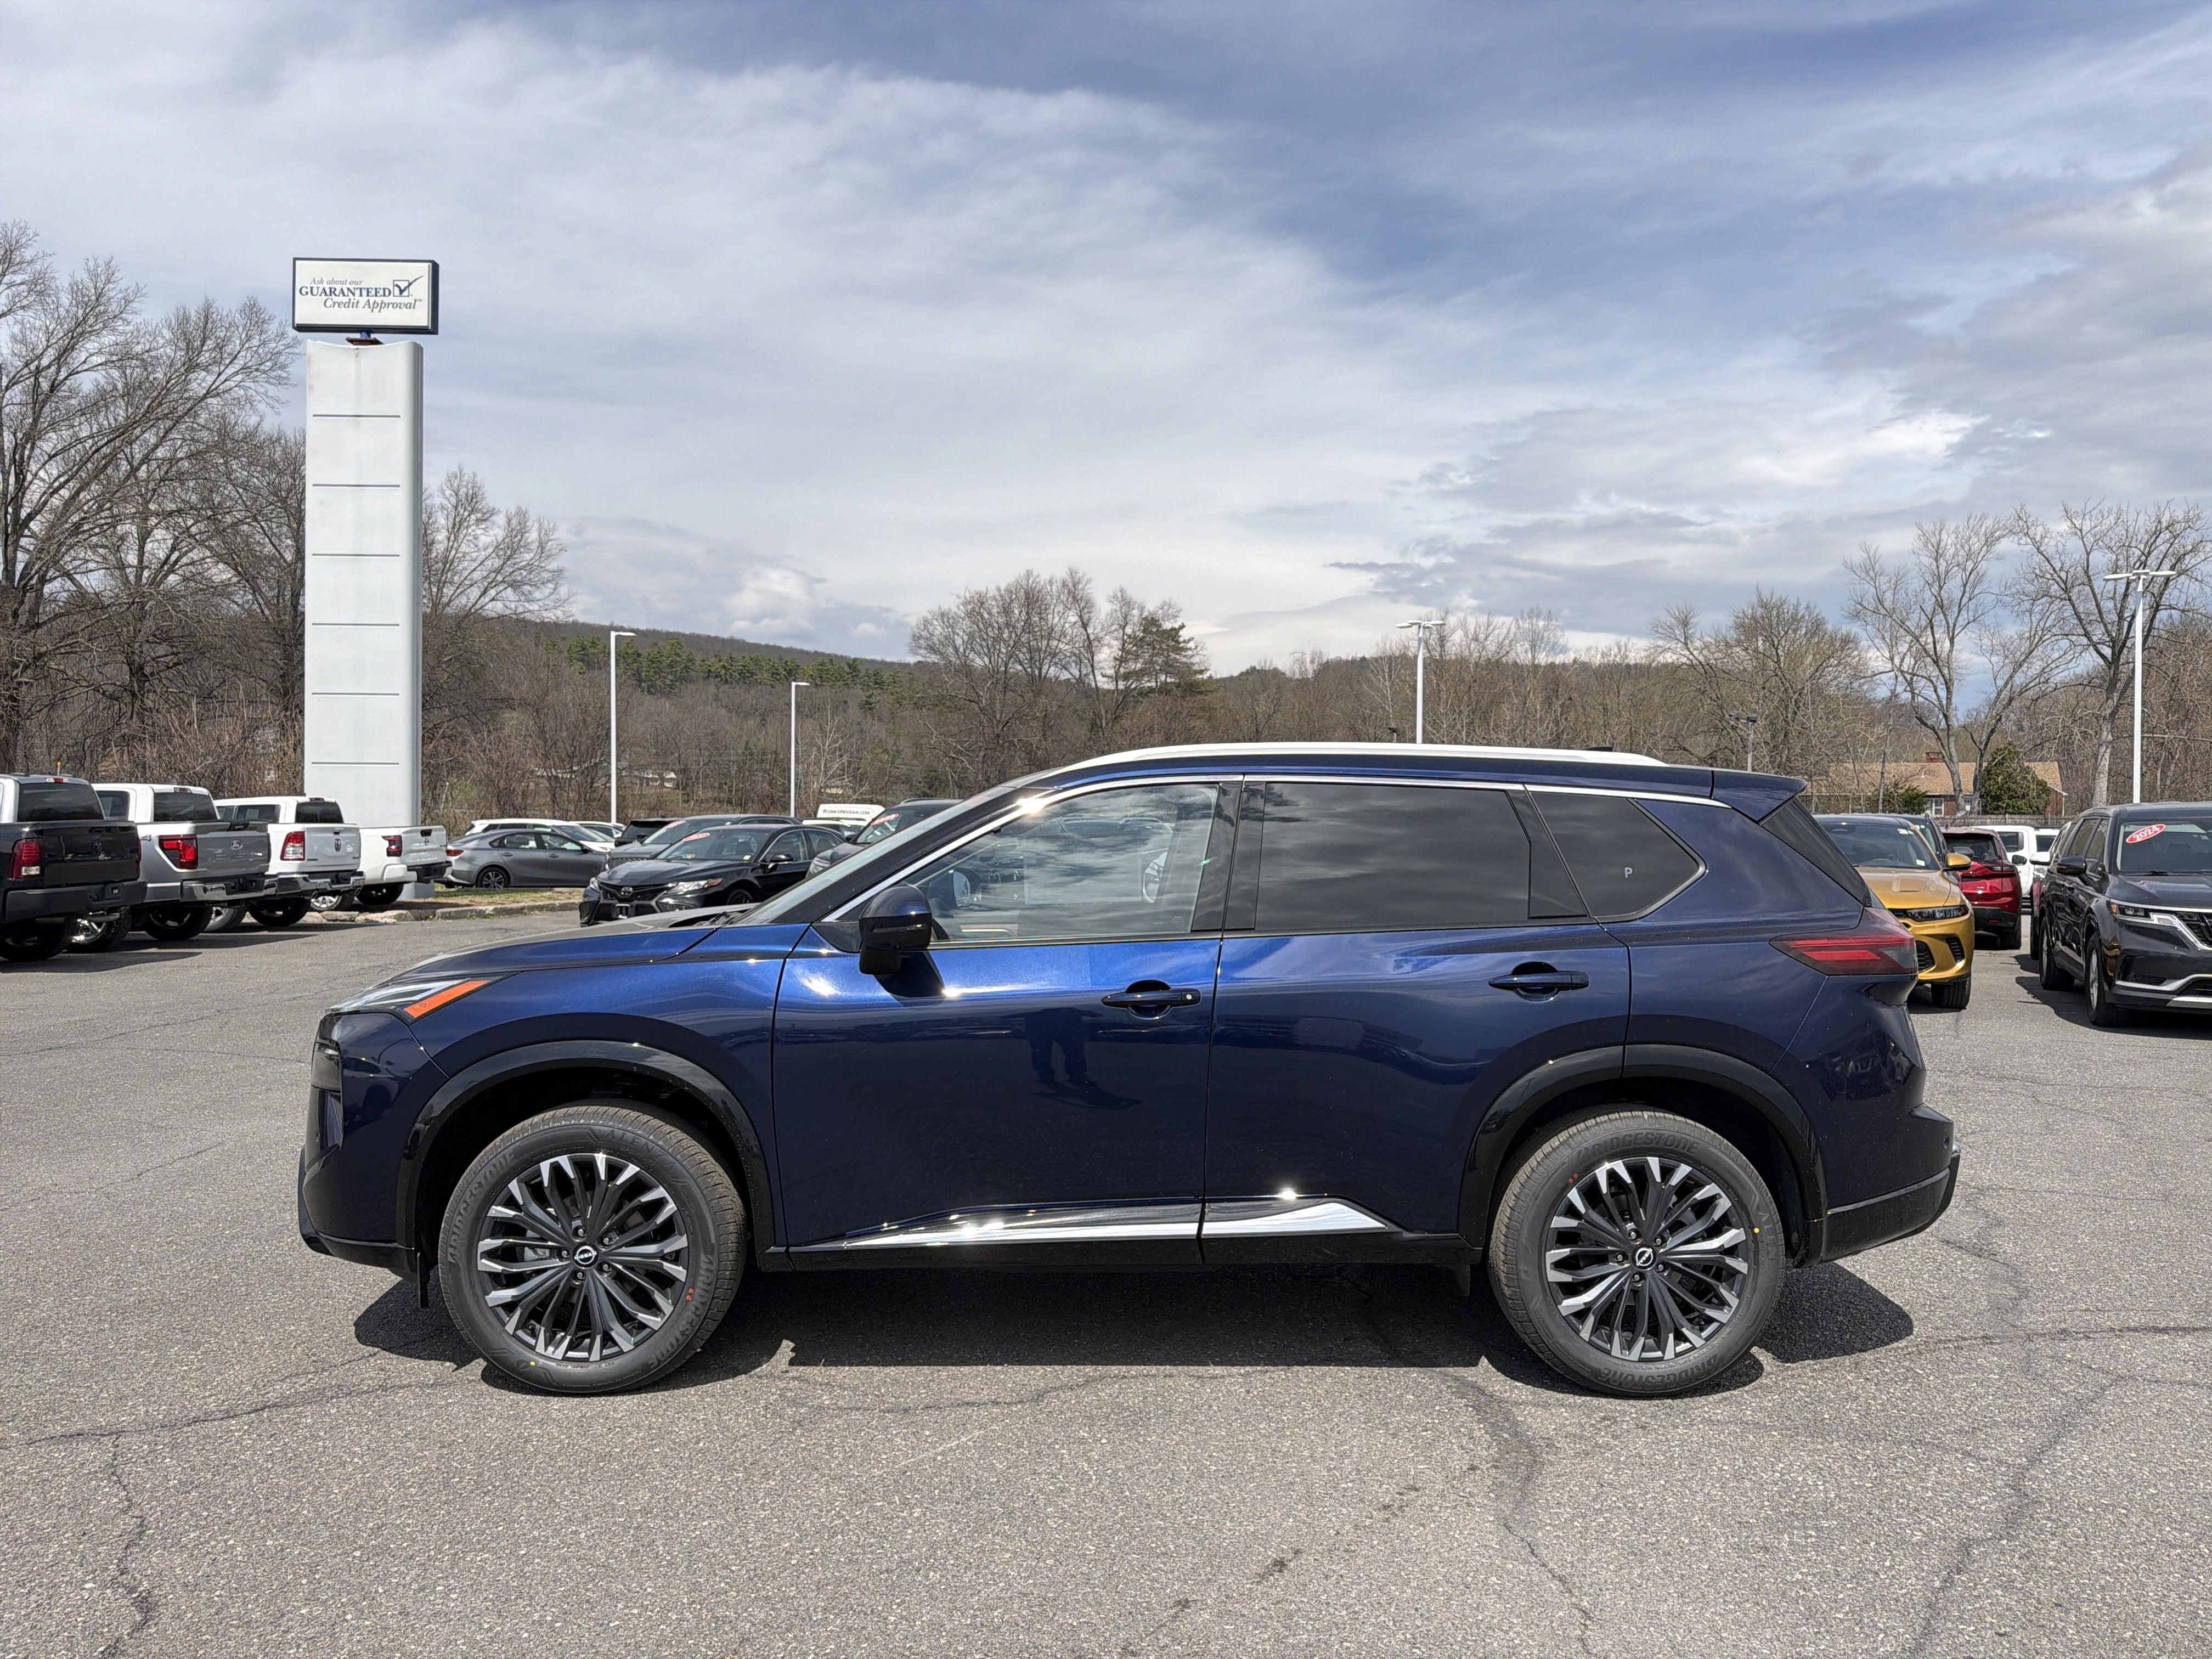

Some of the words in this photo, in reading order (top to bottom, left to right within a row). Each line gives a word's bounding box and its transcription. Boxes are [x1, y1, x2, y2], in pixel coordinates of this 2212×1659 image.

[299, 286, 392, 297] GUARANTEED
[323, 298, 360, 309] Credit
[362, 298, 417, 313] Approval
[2132, 826, 2160, 840] 2024
[1624, 867, 1633, 878] P
[1576, 1131, 1702, 1158] BRIDGESTONE
[447, 1150, 517, 1263] BRIDGESTONE
[574, 1250, 597, 1261] NISSAN
[1636, 1248, 1653, 1267] NISSAN
[648, 1252, 716, 1369] BRIDGESTONE
[1596, 1353, 1720, 1390] BRIDGESTONE
